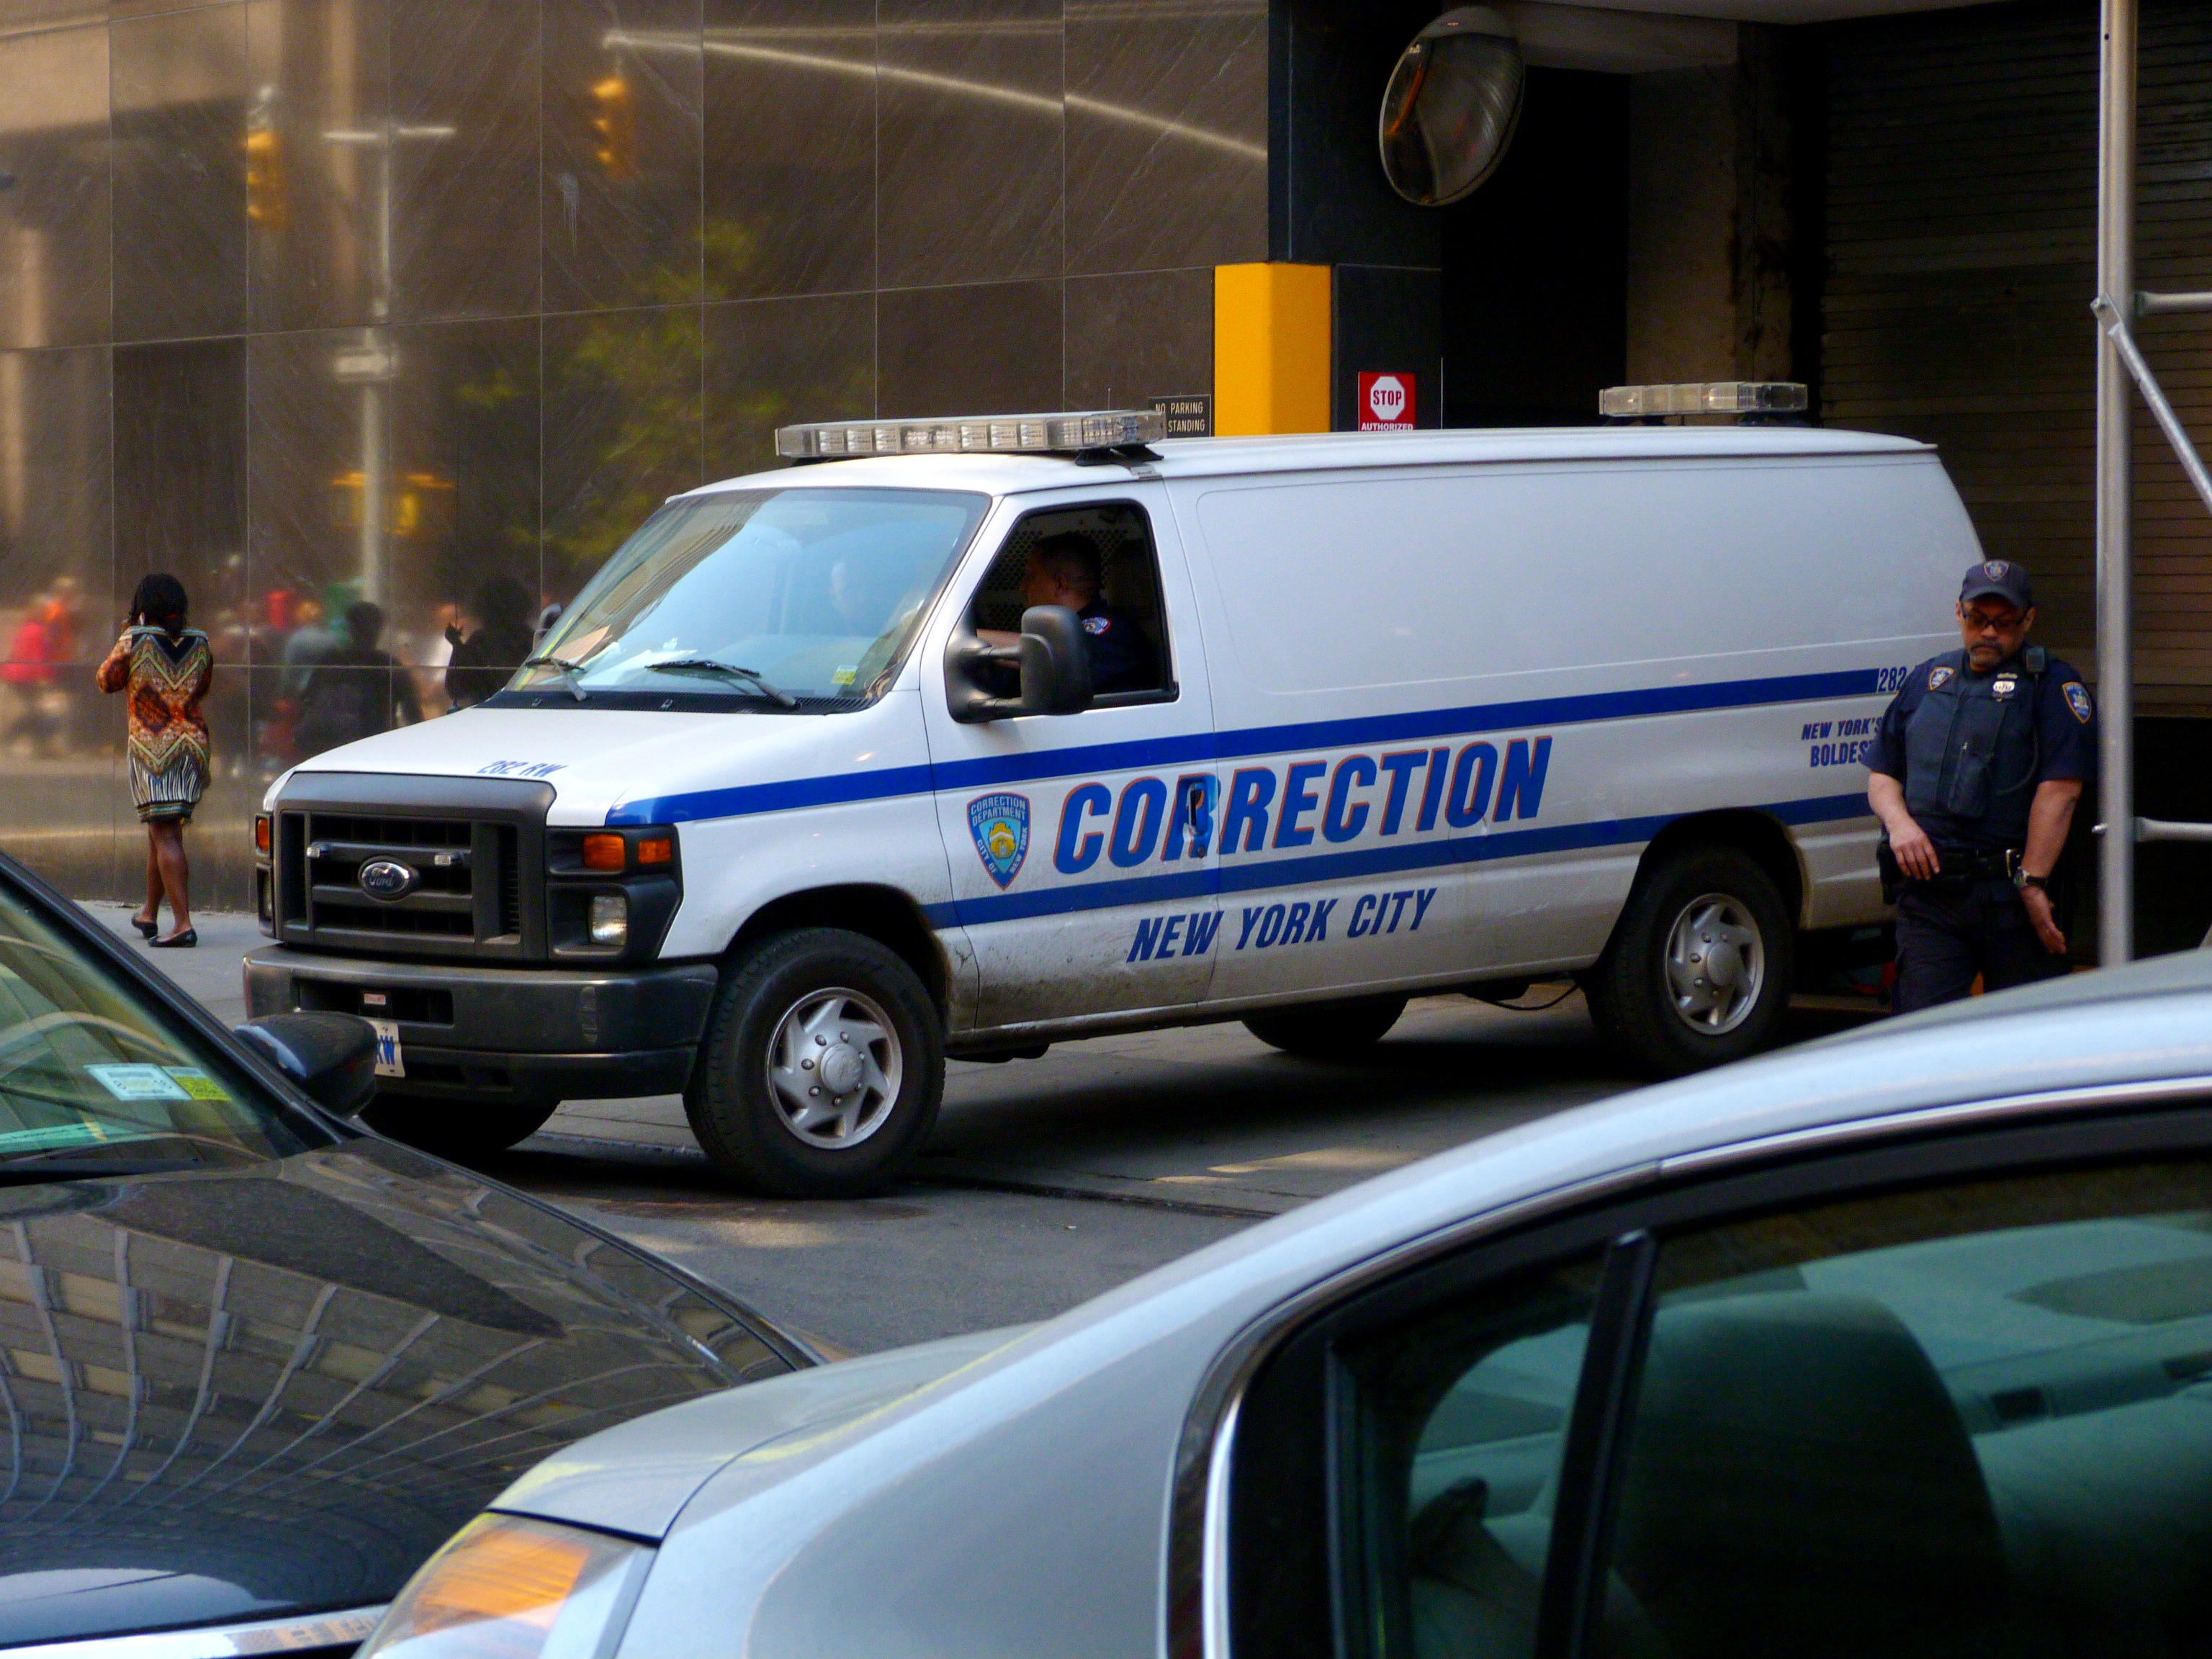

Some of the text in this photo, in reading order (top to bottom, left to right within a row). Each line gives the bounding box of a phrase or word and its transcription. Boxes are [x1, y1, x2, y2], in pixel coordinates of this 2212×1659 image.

[1155, 401, 1204, 415] NO PARKING
[1373, 390, 1402, 405] STOP
[1168, 418, 1205, 432] STANDING
[1361, 422, 1413, 431] AUTHORIZED
[1801, 721, 1833, 740] NEW
[1810, 739, 1874, 768] BOLDES
[476, 760, 529, 775] 282
[971, 795, 1025, 816] CORRECTION
[1053, 734, 1554, 875] CORRECTION
[972, 806, 1026, 827] DEPARTMENT
[977, 839, 990, 860] CITY
[1010, 827, 1028, 873] NEW YORK
[1126, 887, 1437, 963] NEW YORK CITY
